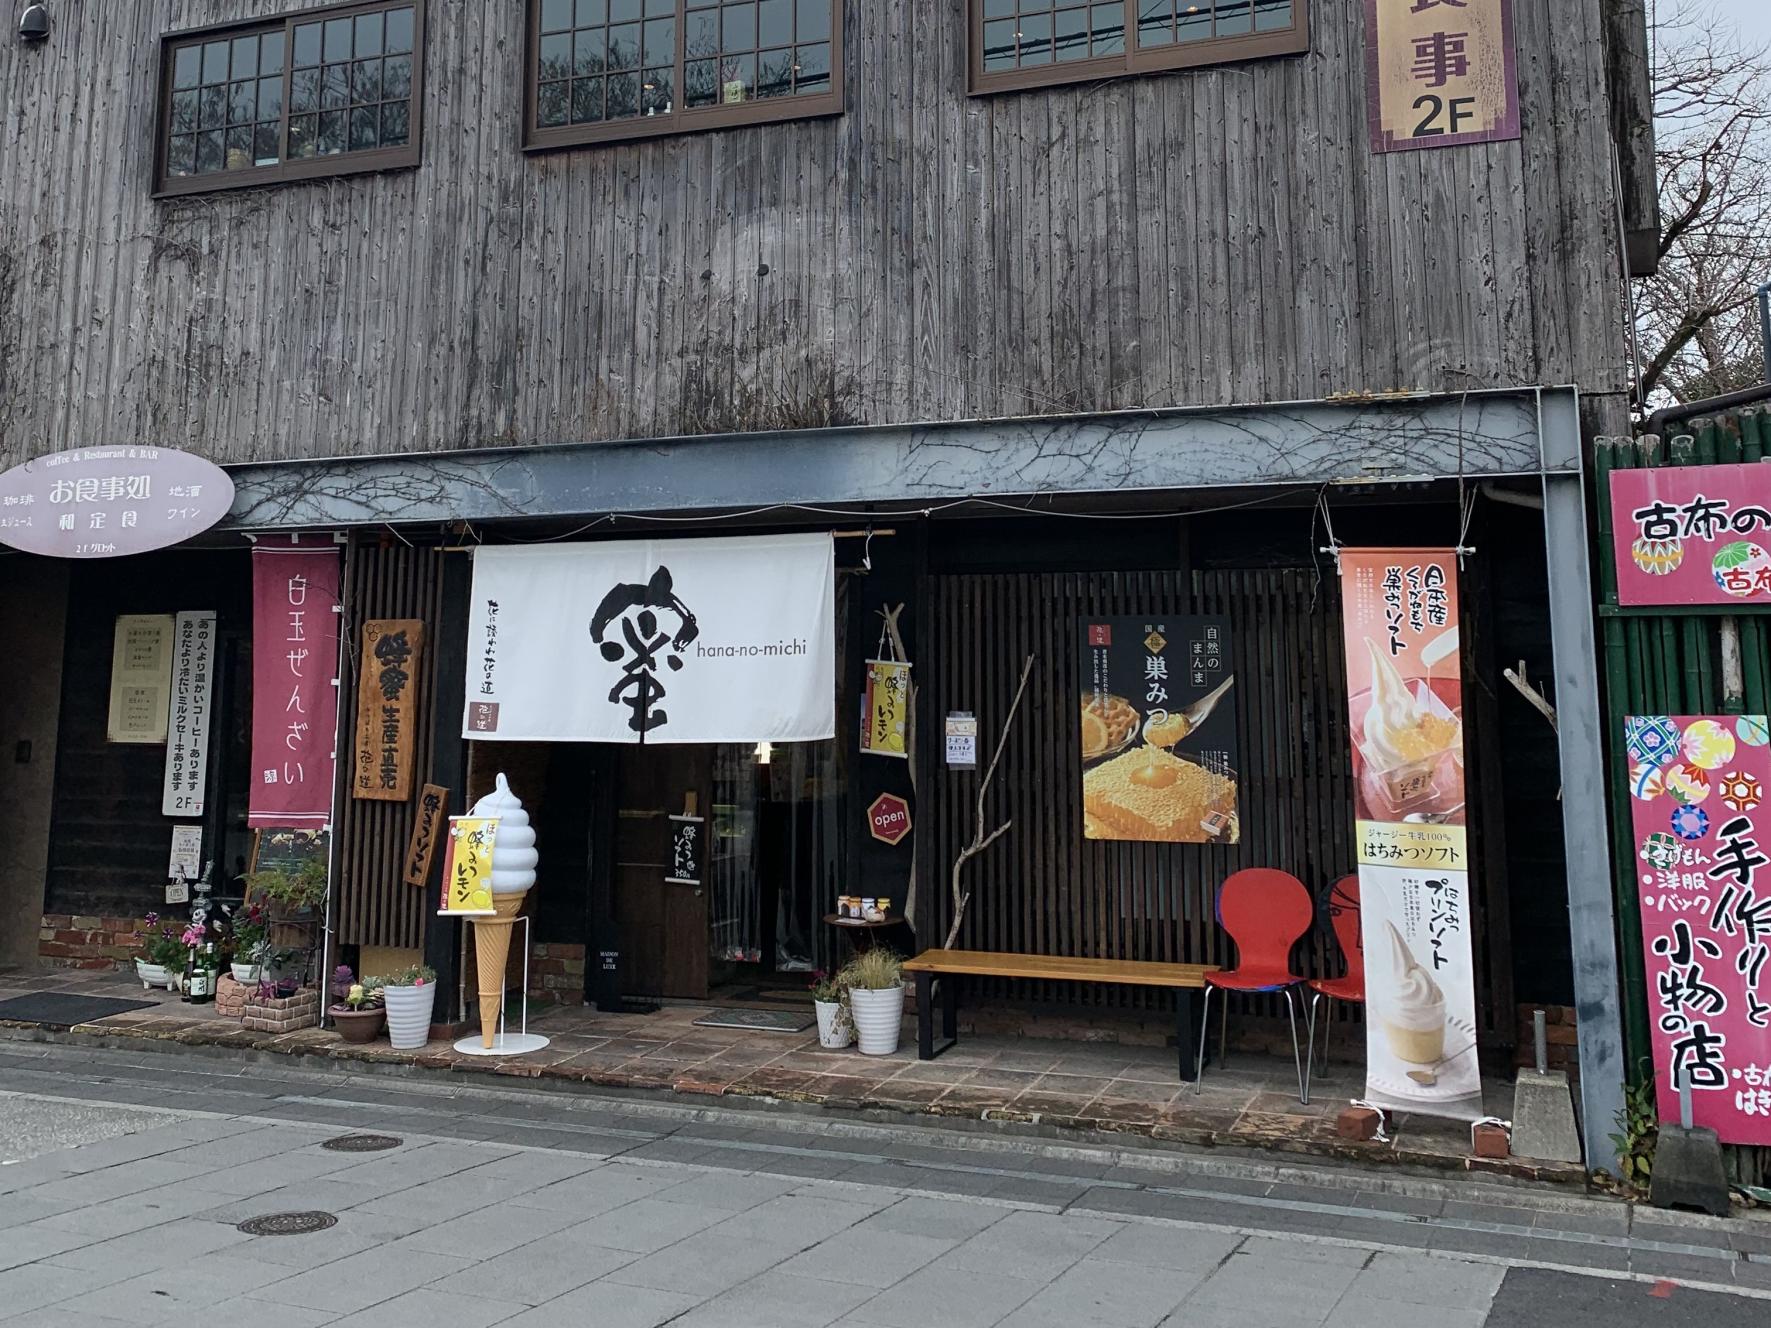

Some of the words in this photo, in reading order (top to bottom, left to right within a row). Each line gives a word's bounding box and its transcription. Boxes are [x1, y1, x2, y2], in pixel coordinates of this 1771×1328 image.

[1410, 0, 1471, 88] 事
[1412, 94, 1475, 138] 2F
[84, 449, 125, 460] Restaurant
[50, 475, 152, 504] お食事処
[168, 485, 202, 498] 地酒
[167, 507, 201, 520] ワイン
[1634, 495, 1771, 540] 古布の
[1424, 565, 1447, 625] 日本産
[697, 639, 807, 658] hana-no-michi
[1193, 642, 1205, 684] まんま
[1206, 626, 1220, 670] 自然の
[284, 574, 309, 785] 白玉ぜんざい
[1144, 656, 1169, 726] 巣みつ
[171, 619, 194, 791] あなたより冷たいミルクセーキあります
[877, 705, 888, 743] レモン
[176, 797, 192, 809] 2F
[874, 811, 905, 828] open
[1364, 842, 1460, 863] はちみつソフト
[457, 863, 470, 903] レモン
[1656, 871, 1709, 891] 洋服
[1425, 878, 1449, 970] プリンソフト
[1444, 887, 1460, 933] はちみつ
[1709, 816, 1771, 1026] 手作りと
[1653, 922, 1727, 1089] 小物の店
